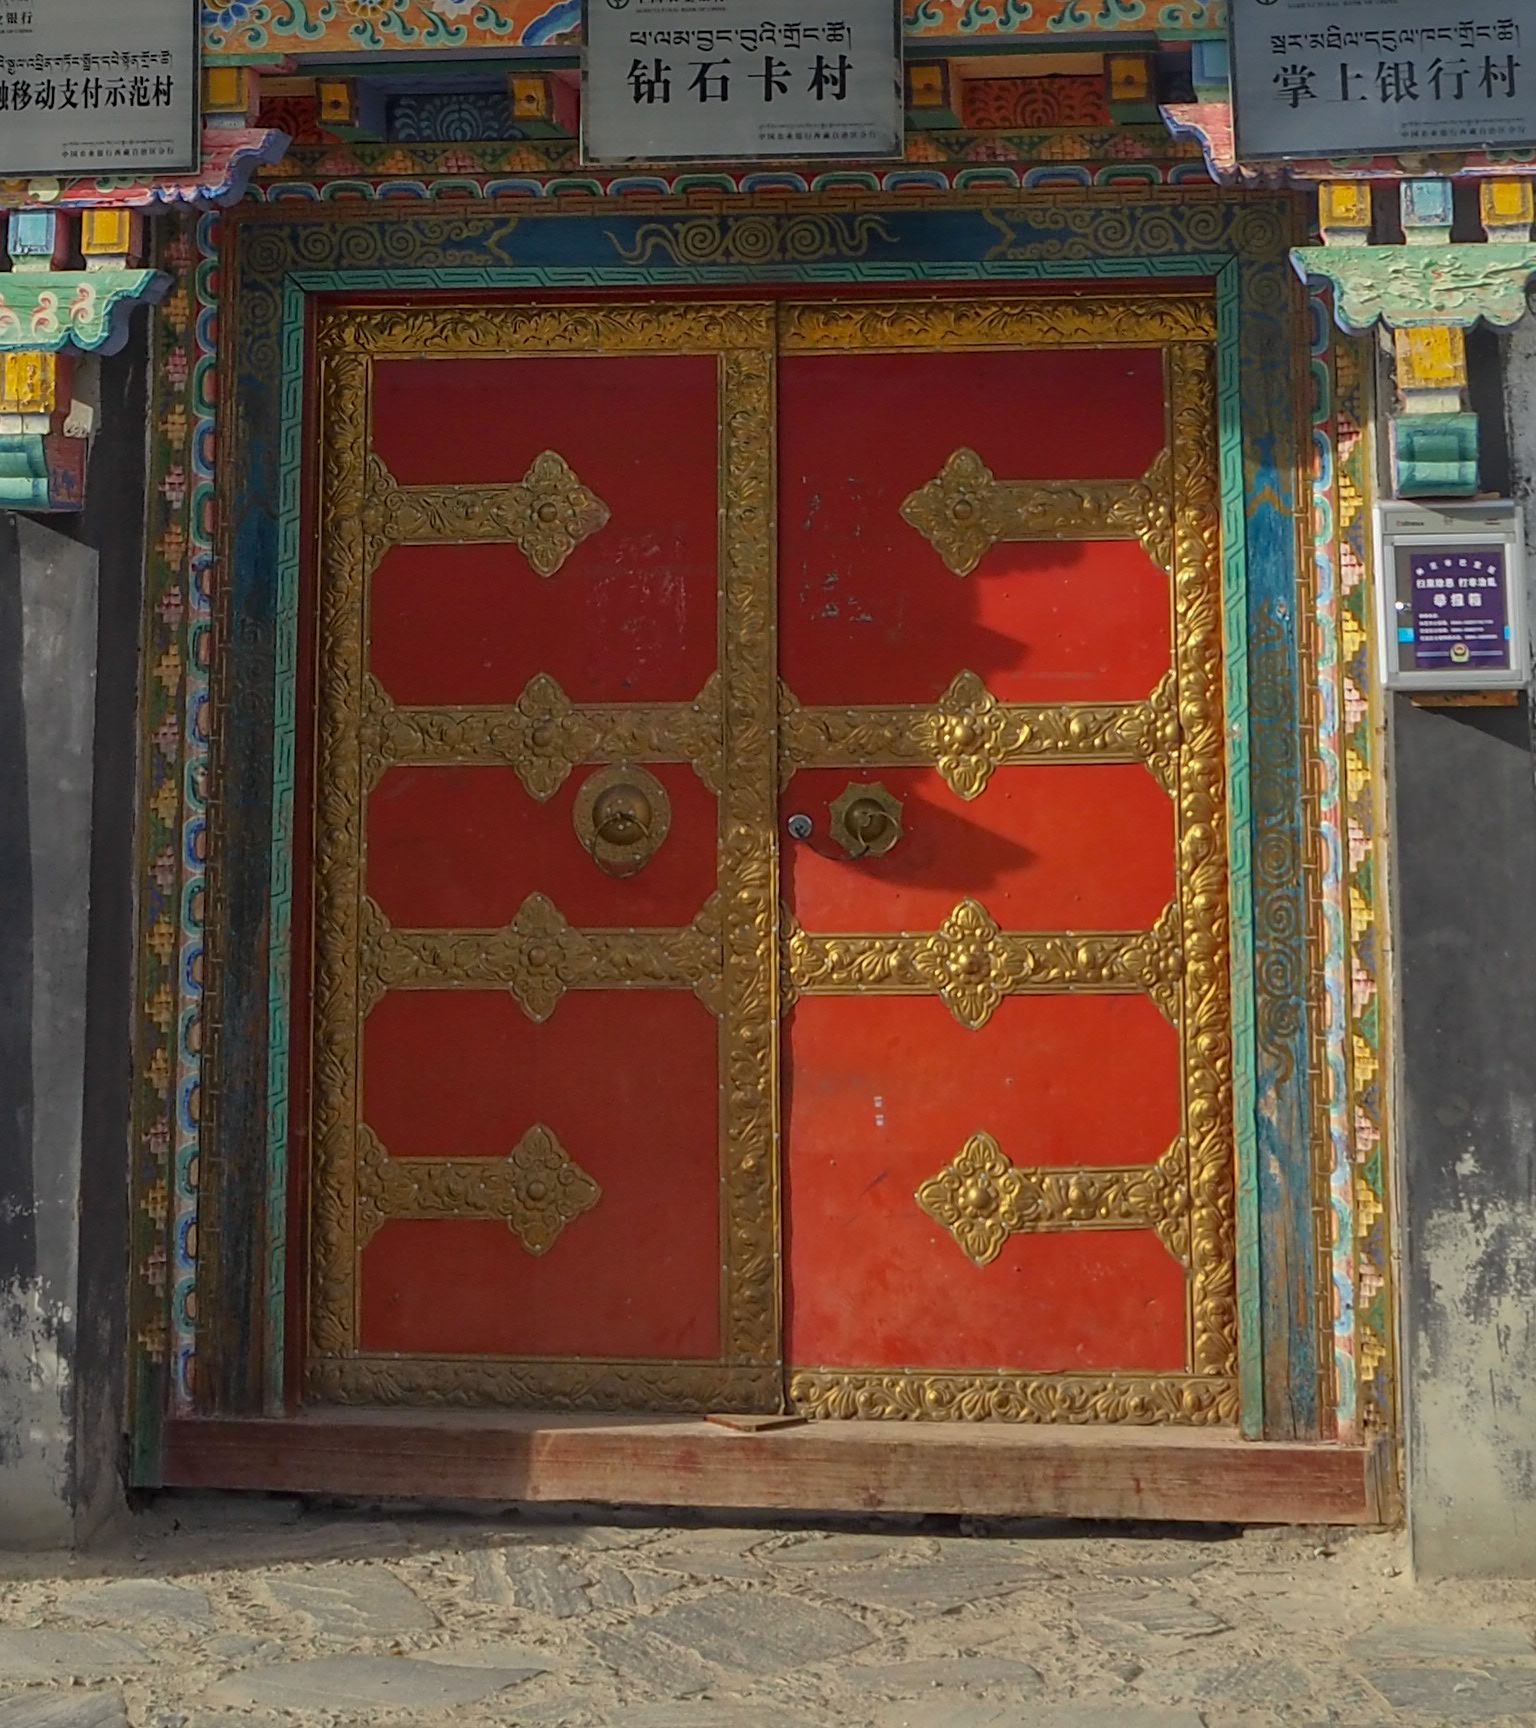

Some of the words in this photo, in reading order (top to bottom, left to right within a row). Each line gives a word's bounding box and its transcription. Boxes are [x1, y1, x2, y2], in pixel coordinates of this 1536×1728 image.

[626, 54, 854, 104] 钻石卡村
[1272, 55, 1521, 109] 掌上银行村
